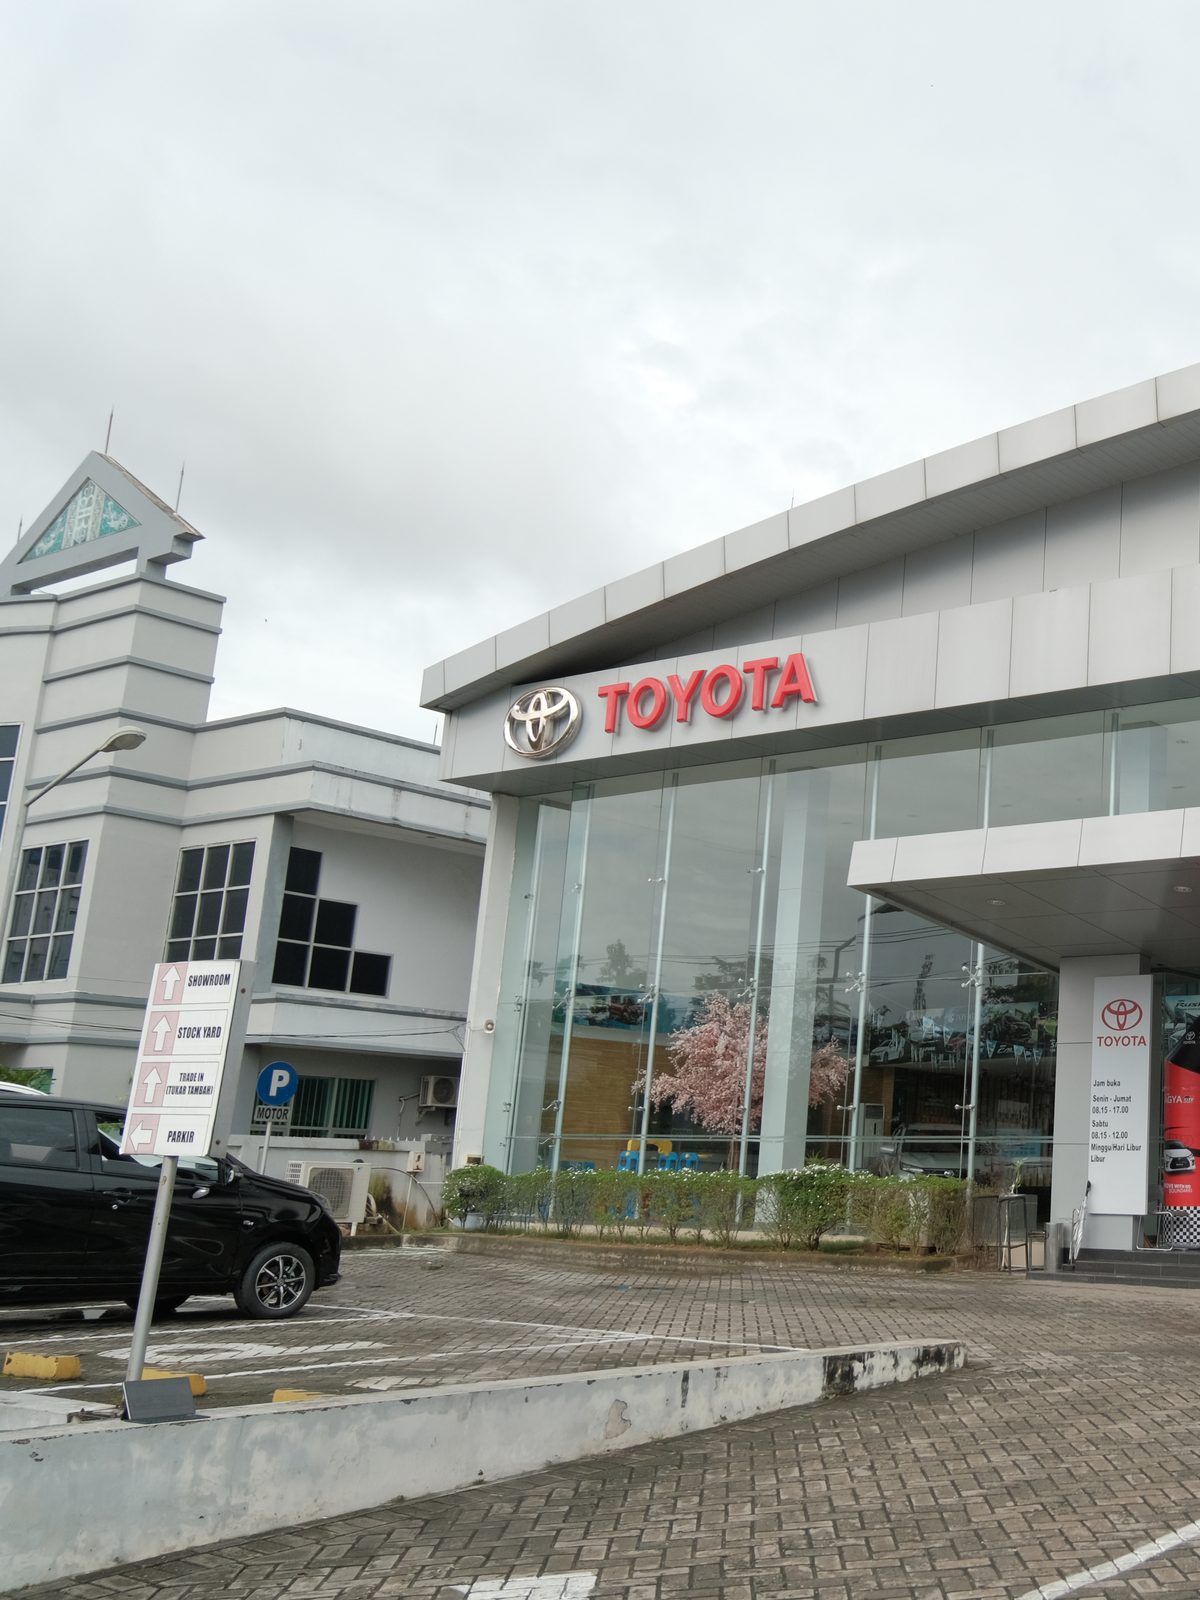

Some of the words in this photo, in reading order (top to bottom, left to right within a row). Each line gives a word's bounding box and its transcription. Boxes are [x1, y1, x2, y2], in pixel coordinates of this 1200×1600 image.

[598, 652, 816, 734] TOYOTA
[188, 974, 231, 987] SHOWROOM
[178, 1027, 201, 1038] STOCK
[202, 1026, 222, 1038] YARD
[1097, 1036, 1146, 1046] TOYOTA
[180, 1073, 197, 1082] TRADE
[198, 1072, 204, 1081] IN
[269, 1070, 290, 1096] P
[166, 1086, 186, 1095] (TUKAR
[187, 1085, 214, 1095] TAMBAH)
[256, 1108, 288, 1120] MOTOR
[167, 1131, 194, 1143] PARKIR
[1091, 1144, 1112, 1152] Minggu
